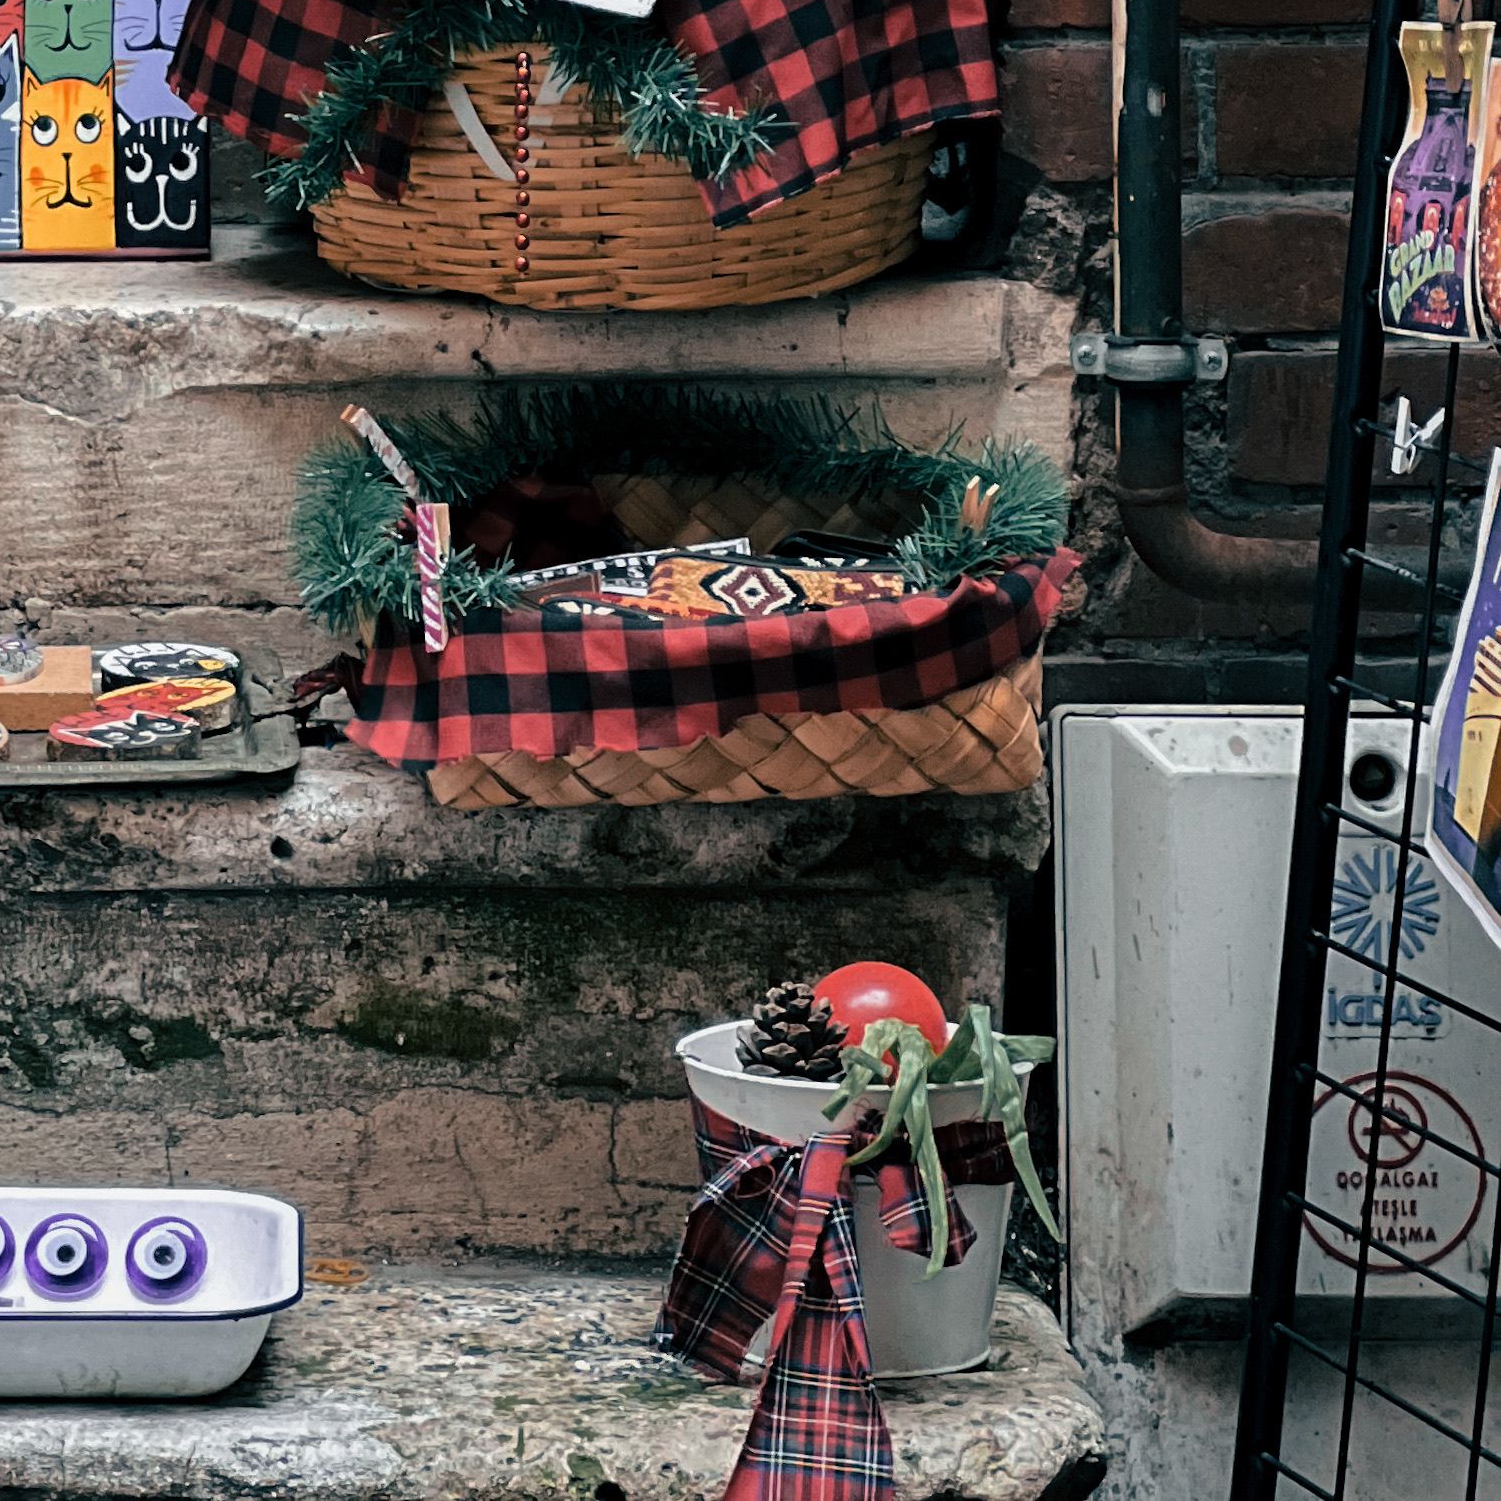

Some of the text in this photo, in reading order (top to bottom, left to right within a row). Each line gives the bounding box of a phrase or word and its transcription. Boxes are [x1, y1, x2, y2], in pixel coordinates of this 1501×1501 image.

[1390, 229, 1435, 278] GRAND
[1336, 1170, 1439, 1189] DOALGAZ
[1361, 1199, 1417, 1221] TEŞLE
